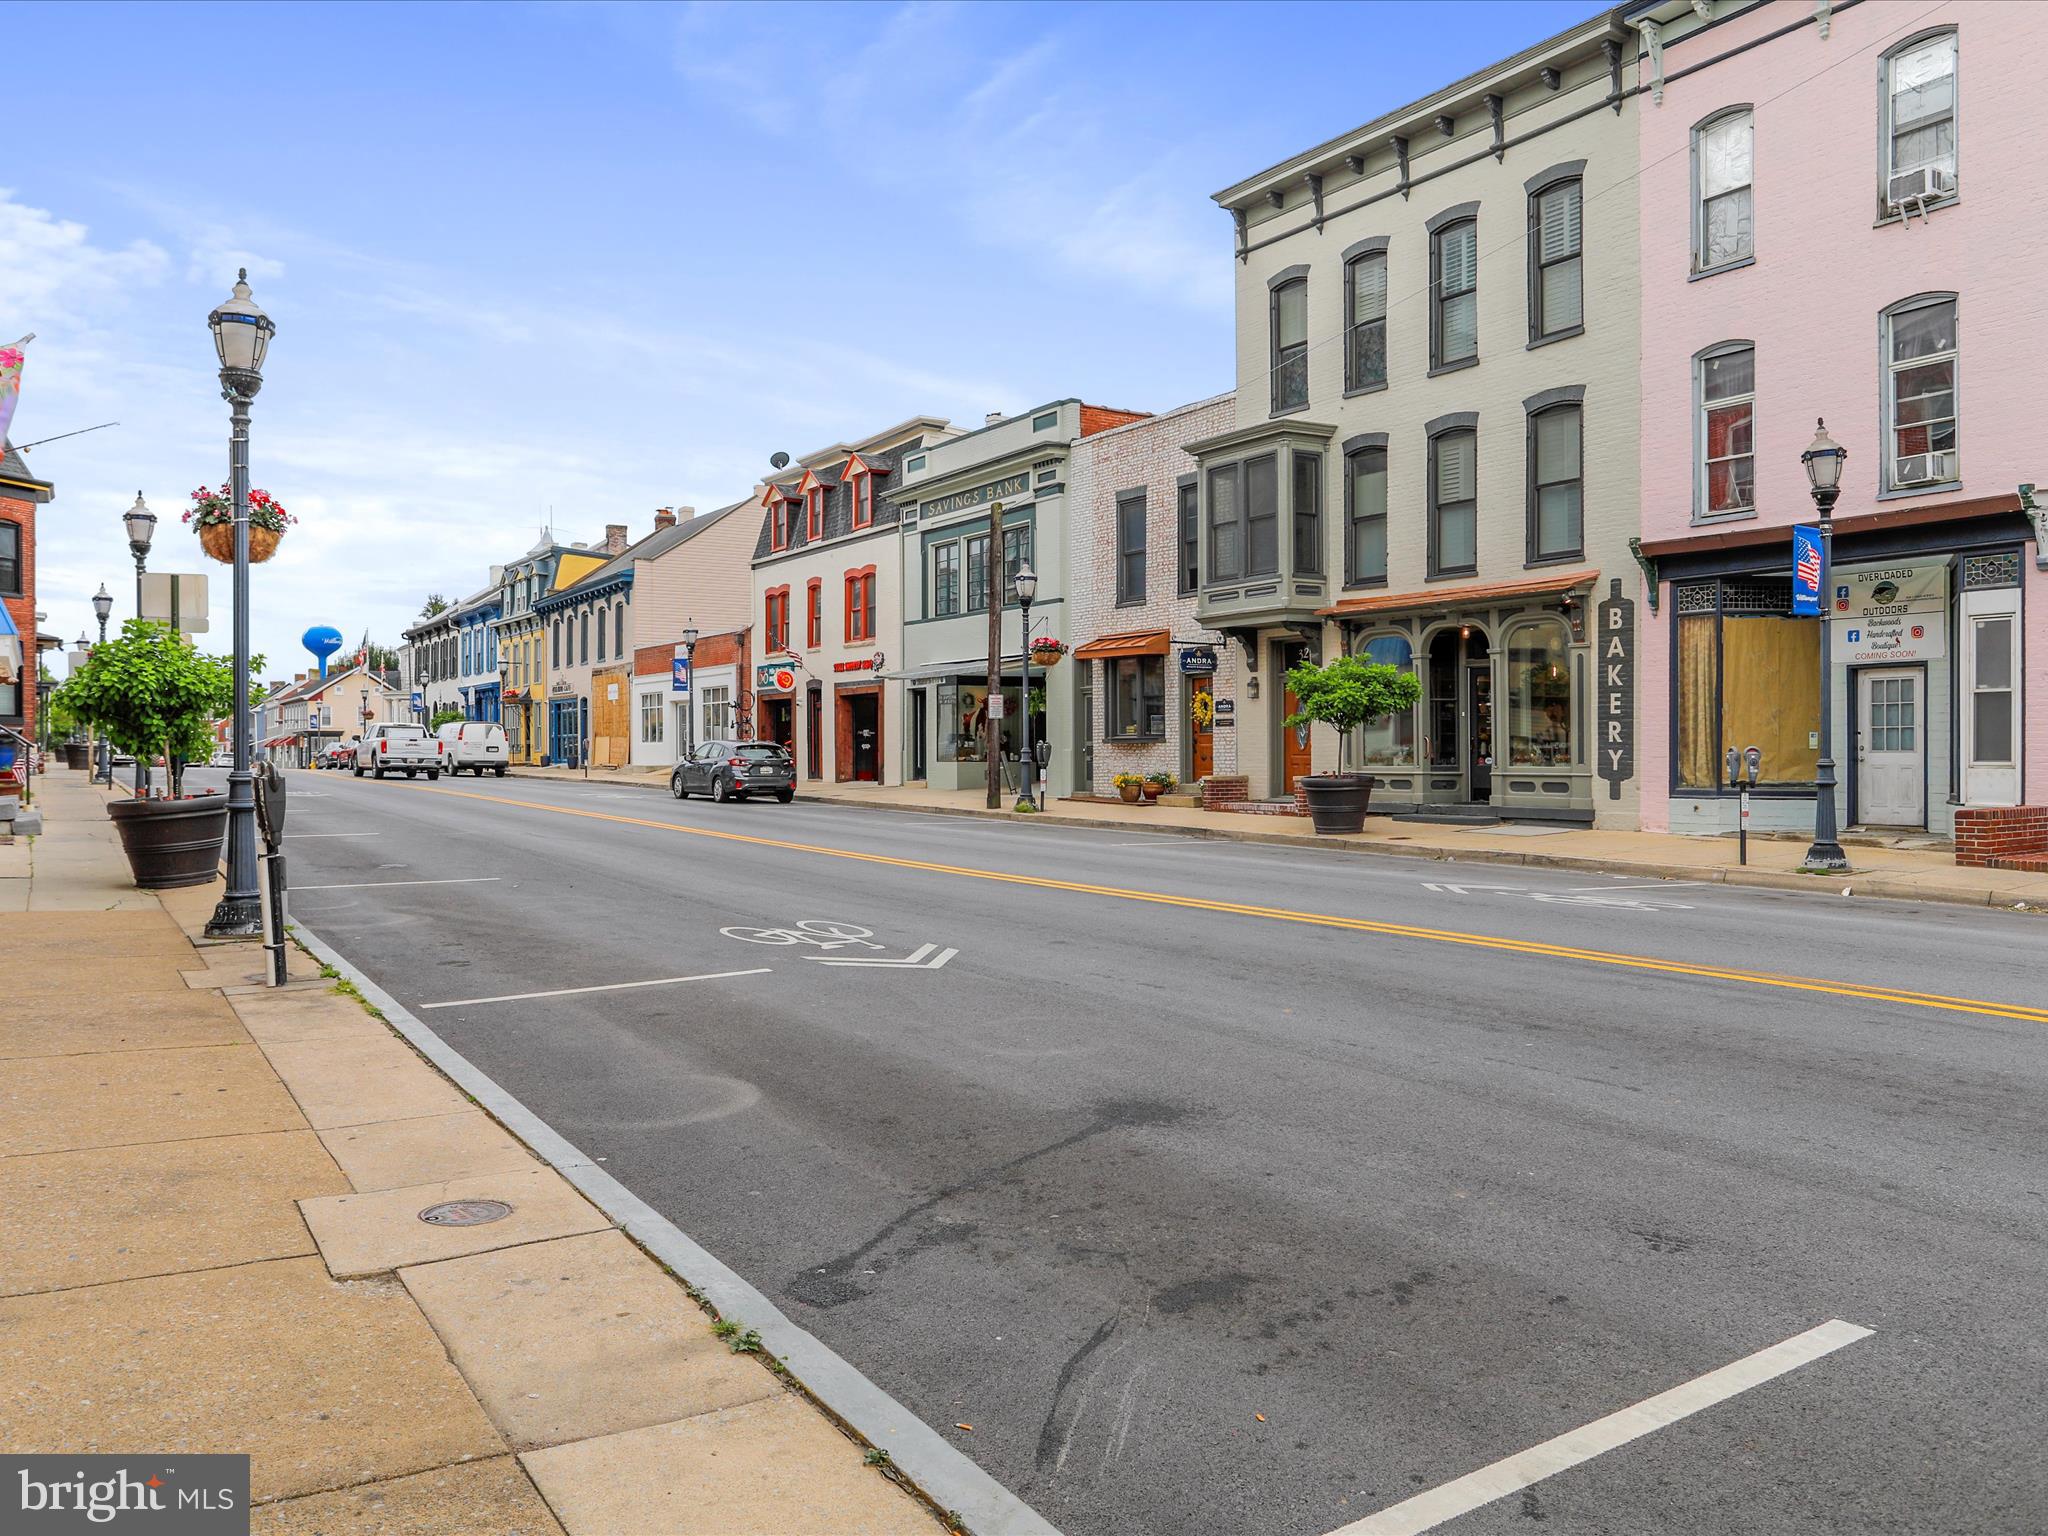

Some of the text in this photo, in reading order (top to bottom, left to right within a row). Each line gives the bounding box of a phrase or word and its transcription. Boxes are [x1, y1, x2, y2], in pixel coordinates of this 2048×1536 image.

[928, 478, 1022, 516] SAVINGS BANK
[1858, 569, 1913, 582] OVERLOADED
[1863, 604, 1908, 615] OUTDOORS
[1867, 617, 1901, 627] Backwoods
[1866, 629, 1903, 639] Handcrafted
[1186, 657, 1213, 665] ANDRA
[1855, 650, 1917, 661] COMING SOON!
[1607, 607, 1625, 771] BAKERY
